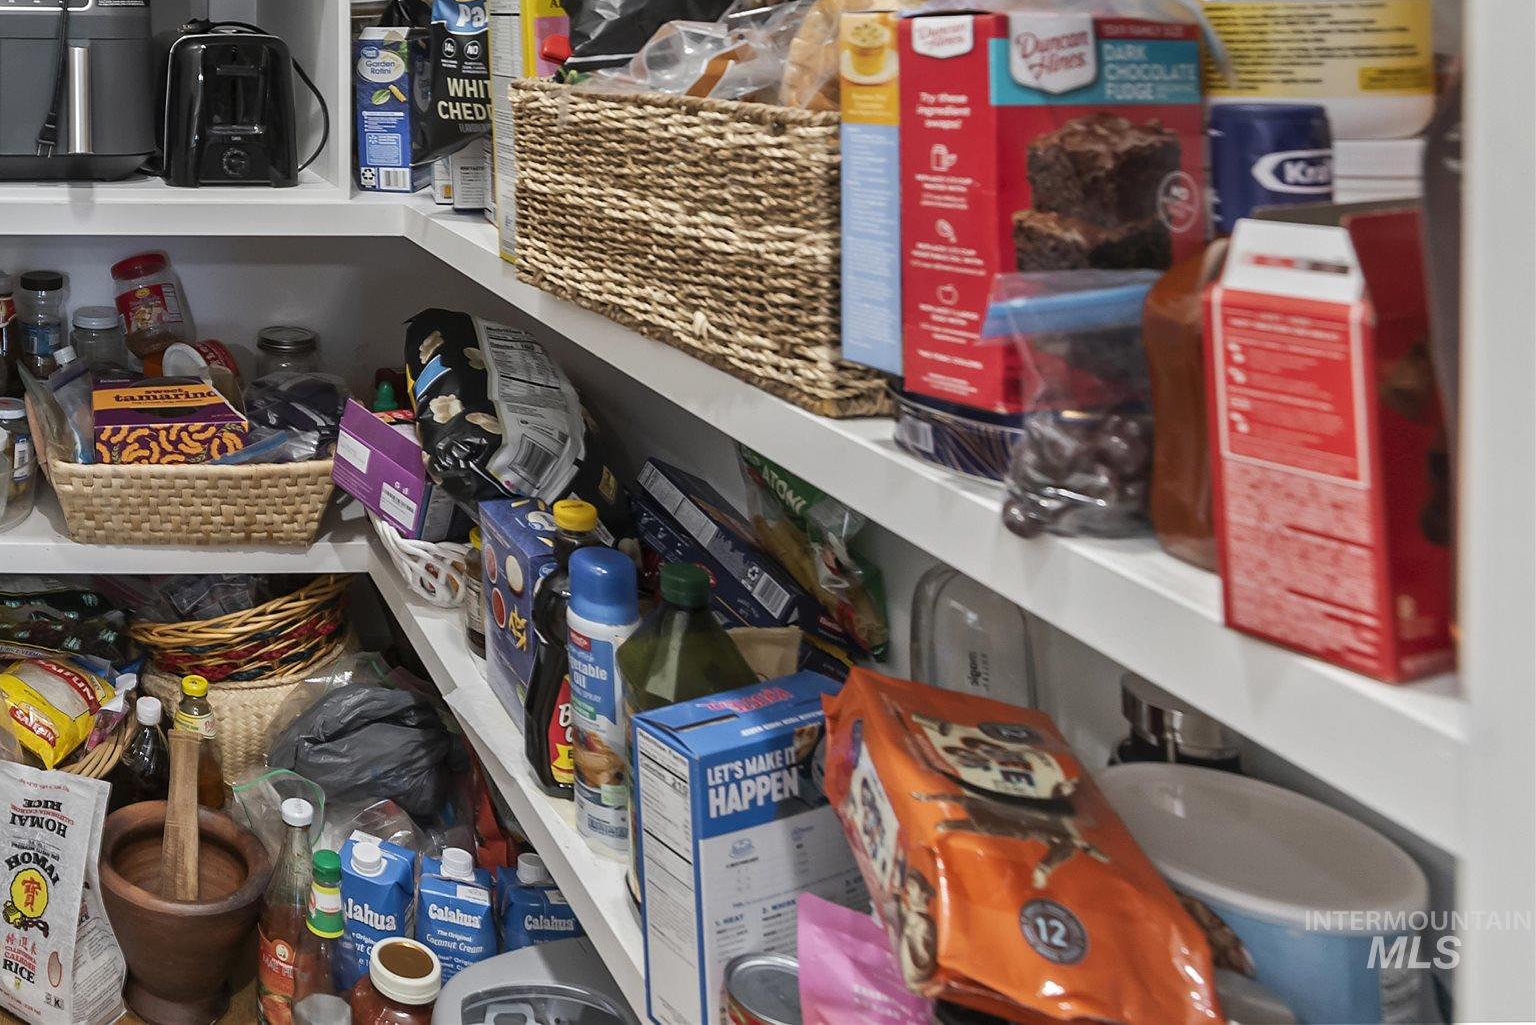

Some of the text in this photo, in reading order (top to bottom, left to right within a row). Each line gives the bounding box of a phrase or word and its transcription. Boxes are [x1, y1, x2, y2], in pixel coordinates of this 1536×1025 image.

[466, 45, 479, 55] NO
[1013, 30, 1090, 59] Duncan
[1101, 44, 1148, 62] DARK
[1027, 50, 1087, 81] Hines
[1103, 63, 1198, 82] CHOCOLATE
[1104, 82, 1154, 101] FUDGE
[706, 746, 797, 786] LET'S MAKE IT
[22, 798, 63, 812] RICE
[708, 766, 800, 819] HAPPEN
[9, 812, 68, 838] HOMAI
[4, 852, 60, 886] HOMAI
[427, 902, 481, 929] Calahua
[524, 914, 575, 931] Calahua
[426, 933, 457, 949] Coconut
[1035, 917, 1068, 948] 12
[2, 958, 36, 985] RICE
